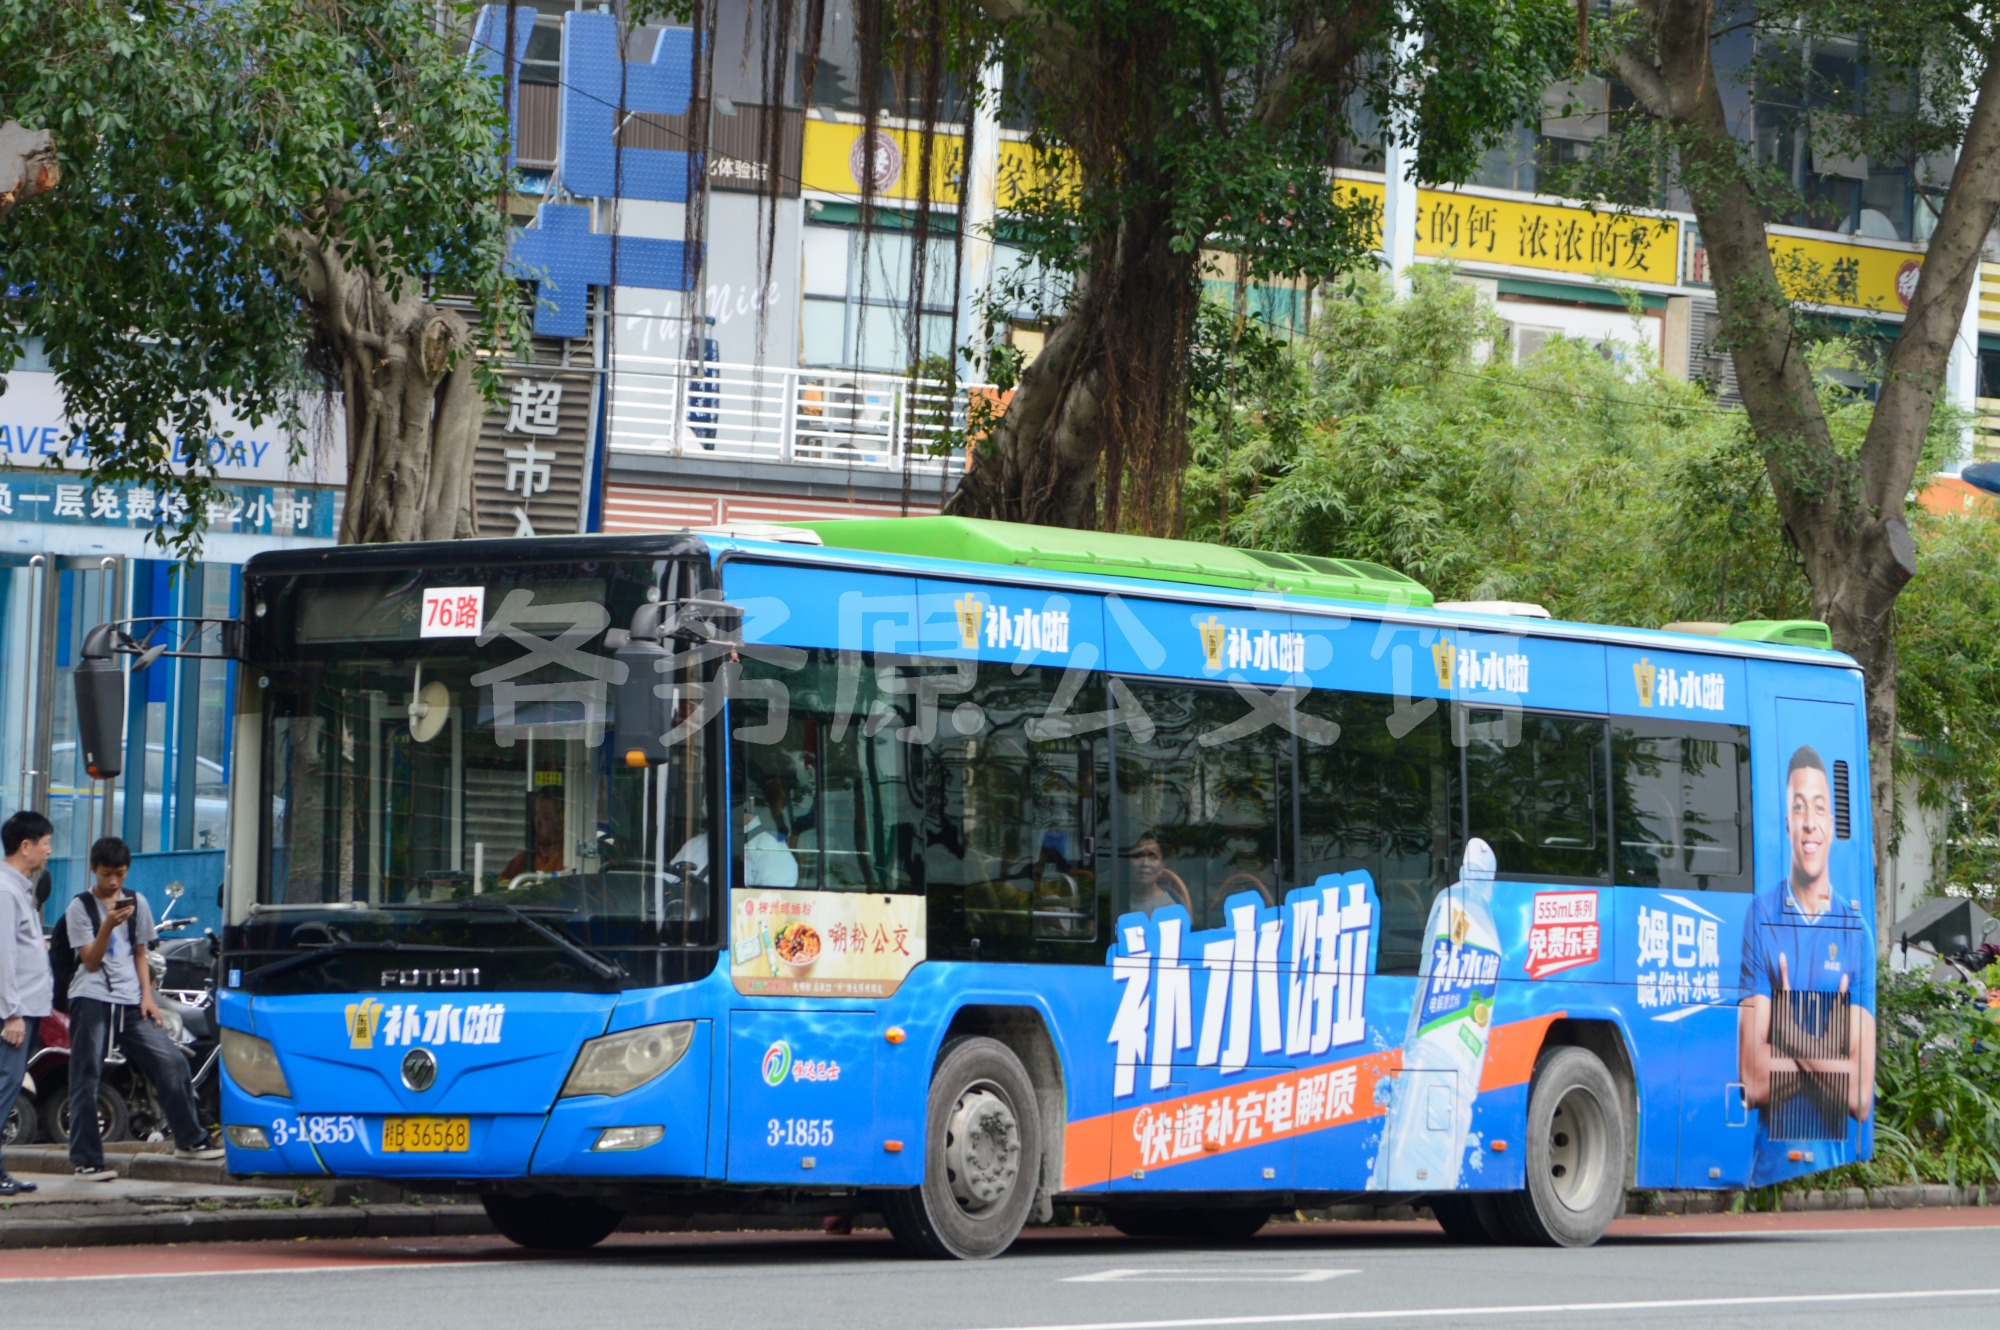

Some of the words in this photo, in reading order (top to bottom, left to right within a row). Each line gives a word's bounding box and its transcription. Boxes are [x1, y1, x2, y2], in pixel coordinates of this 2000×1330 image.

[206, 438, 270, 468] DAY
[426, 594, 479, 629] 76路
[984, 604, 1069, 653] 补水啦
[1227, 627, 1305, 673] 补水啦
[1457, 648, 1529, 693] 补水啦
[1657, 667, 1725, 711] 补水啦
[1538, 900, 1593, 919] 555mL系列
[1525, 925, 1599, 970] 免费乐享
[1636, 905, 1720, 968] 姆巴佩
[381, 968, 480, 987] FOTON
[1432, 941, 1500, 994] 补水啦
[1636, 970, 1721, 1009] 喊你补水啦
[1107, 883, 1372, 1098] 补水啦
[382, 1004, 507, 1046] 补水啦
[272, 1115, 356, 1146] 3-1855
[766, 1118, 834, 1147] 3-1855
[1139, 1065, 1358, 1166] 快速补充电解质
